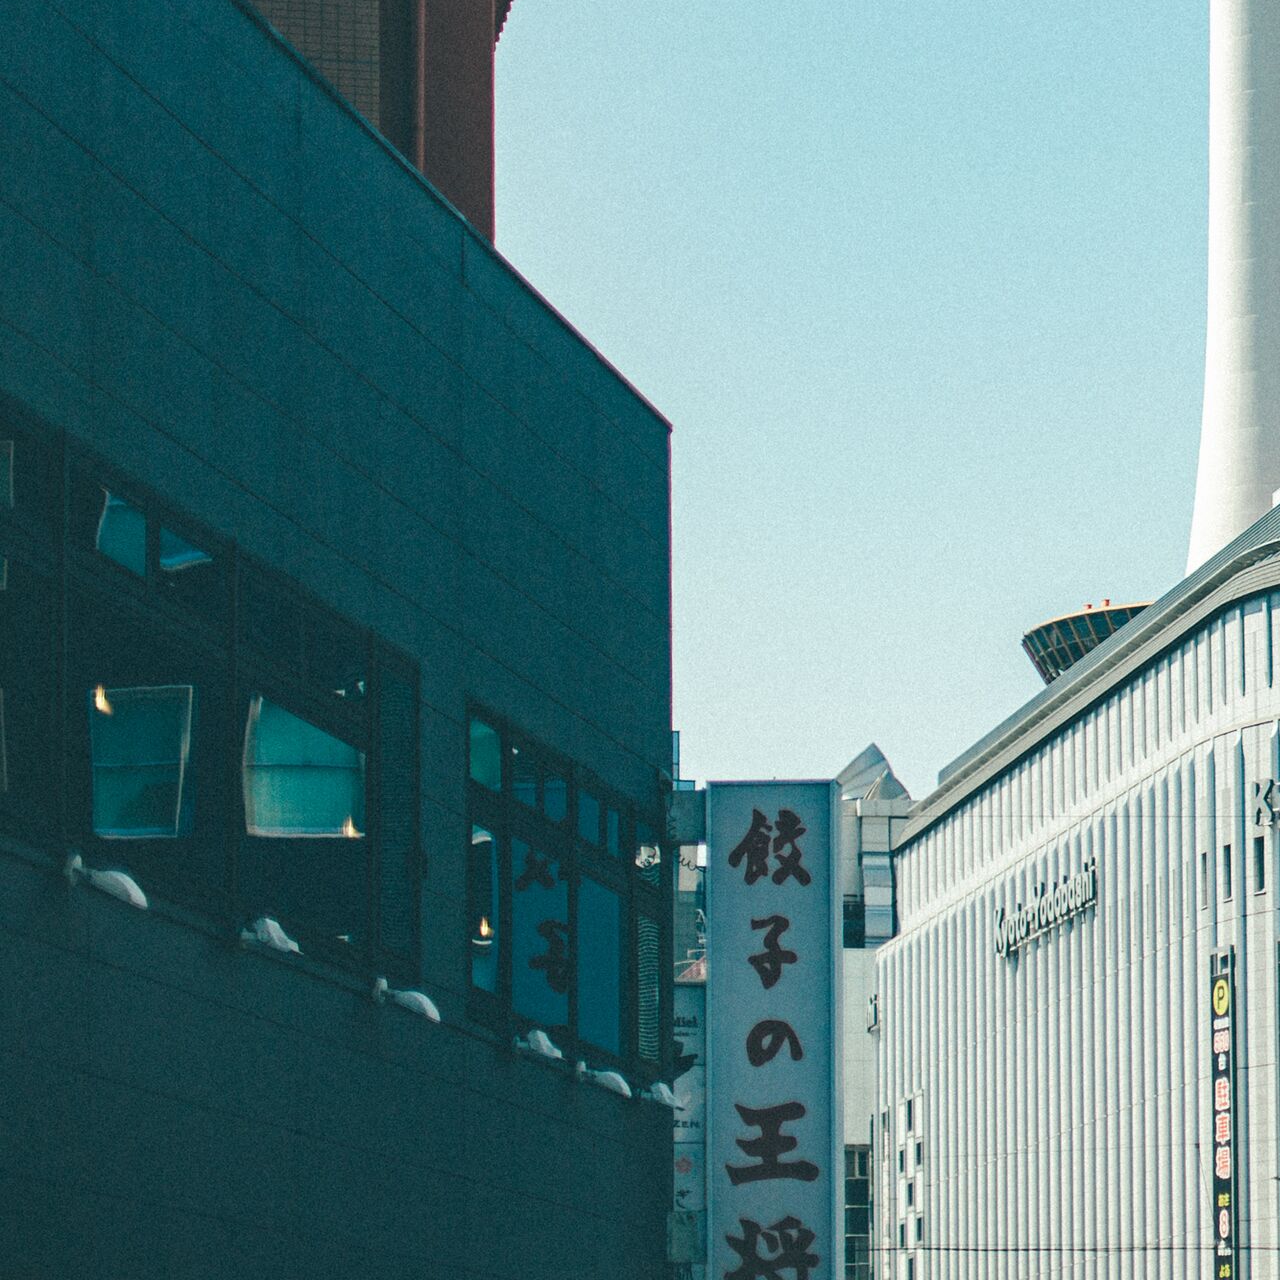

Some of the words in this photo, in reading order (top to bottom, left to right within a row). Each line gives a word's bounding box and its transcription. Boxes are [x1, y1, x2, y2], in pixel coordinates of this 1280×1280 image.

[723, 808, 821, 1280] 餃子の王将
[993, 857, 1096, 960] Kyoto-Yodobashi
